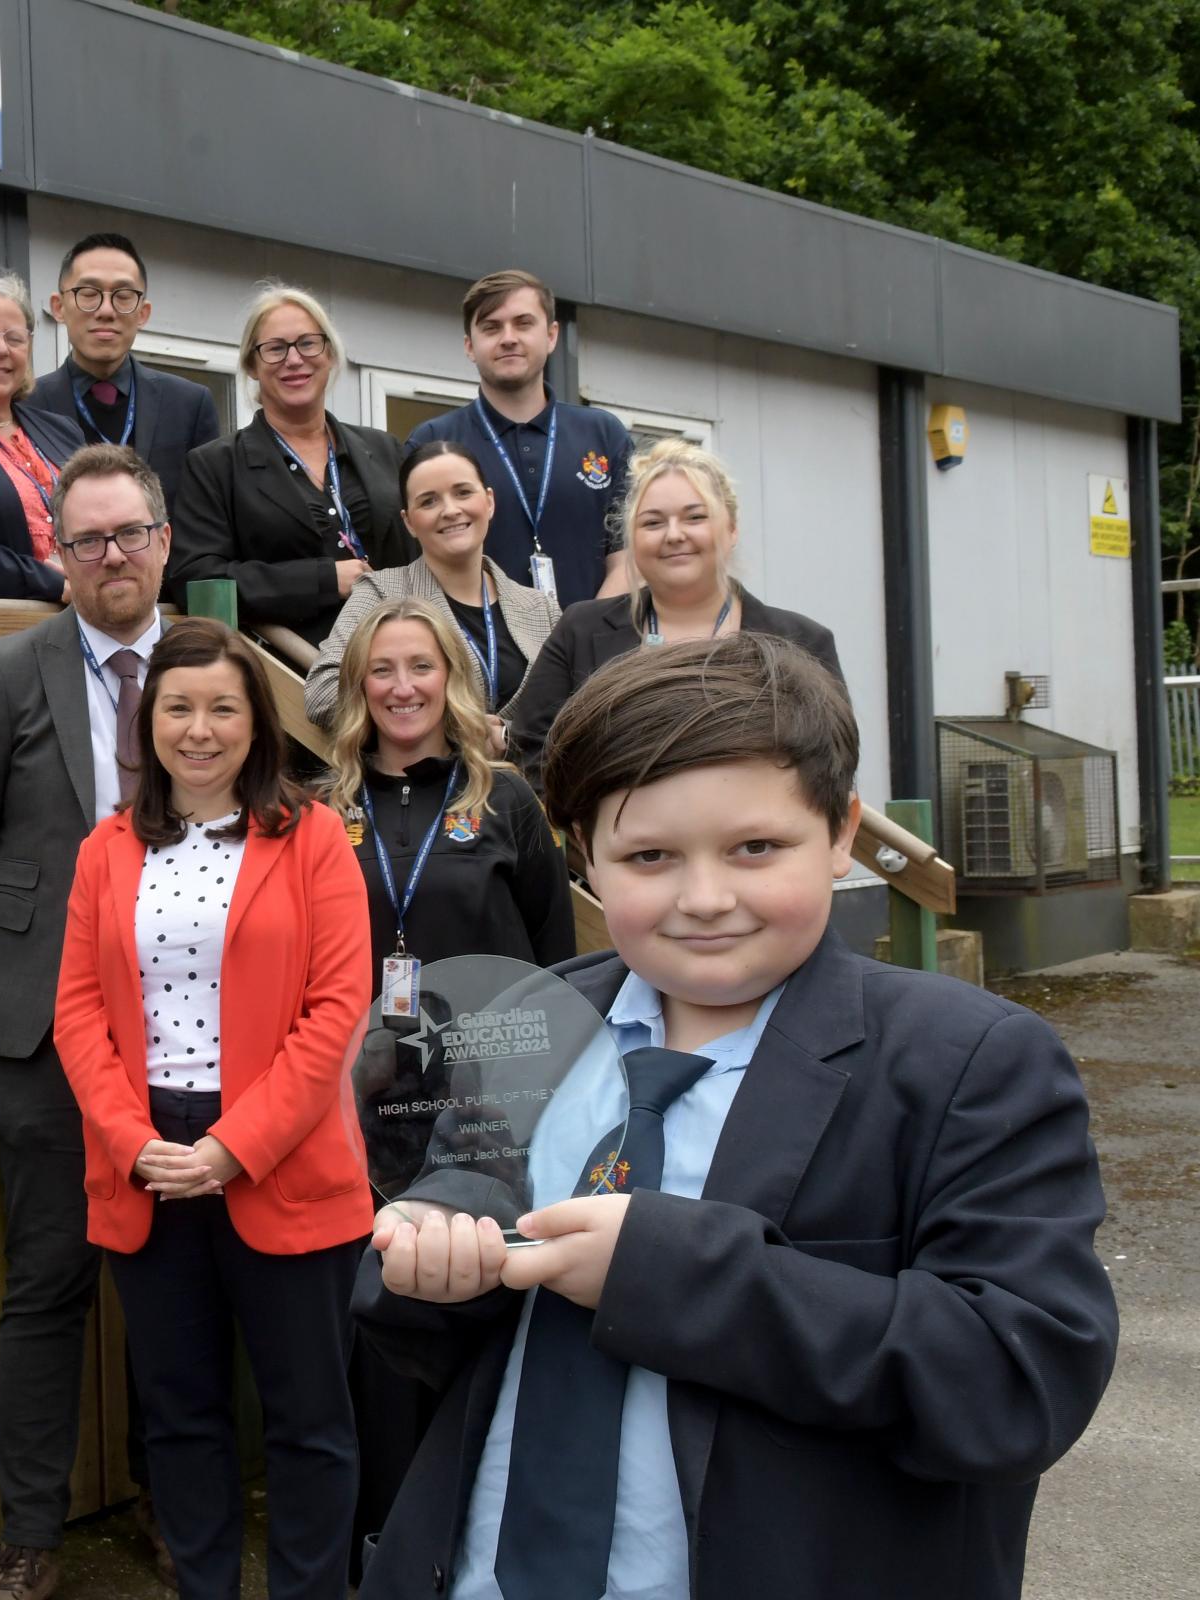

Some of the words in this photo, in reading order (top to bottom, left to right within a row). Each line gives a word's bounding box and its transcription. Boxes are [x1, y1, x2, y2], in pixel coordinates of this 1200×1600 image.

[456, 1007, 547, 1030] Guardian
[441, 1022, 548, 1047] EDUCATION
[443, 1042, 511, 1061] AWARDS
[512, 1038, 551, 1054] 2024
[378, 1103, 409, 1116] HIGH
[412, 1099, 463, 1113] SCHOOL
[465, 1095, 500, 1107] PUPIL
[503, 1091, 520, 1103] OF
[521, 1089, 549, 1102] THE
[458, 1120, 510, 1135] WINNER
[431, 1153, 471, 1165] Nathan
[474, 1148, 500, 1161] Jack
